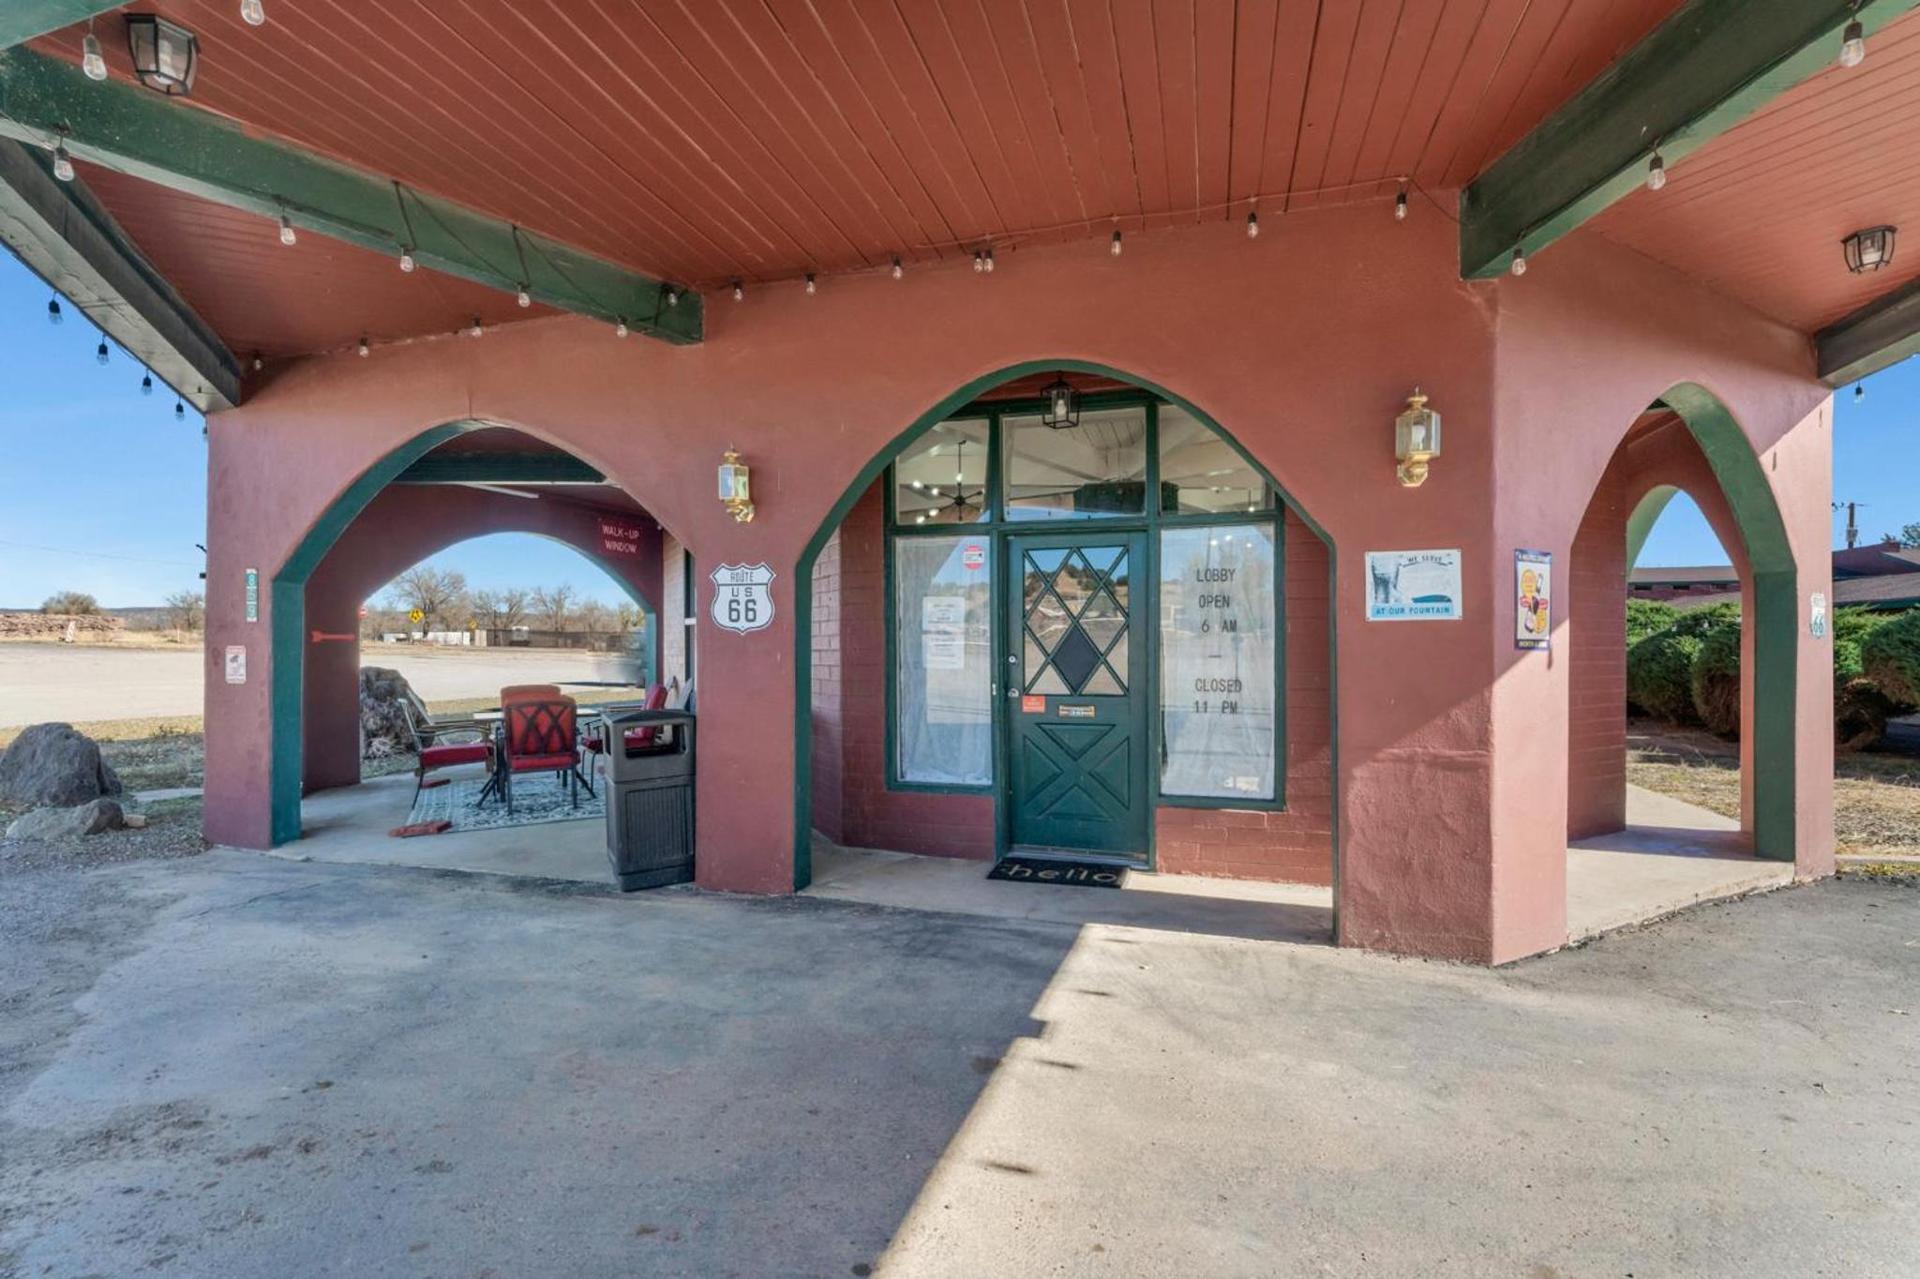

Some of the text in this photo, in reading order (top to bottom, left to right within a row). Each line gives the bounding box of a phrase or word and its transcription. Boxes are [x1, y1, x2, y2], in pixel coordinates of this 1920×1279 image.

[601, 524, 640, 540] WALK-UP
[604, 539, 638, 553] WINDOW
[730, 570, 754, 583] ROUTE
[1196, 567, 1236, 582] LOBBY
[1198, 594, 1231, 609] OPEN
[728, 598, 757, 623] 66
[1376, 606, 1450, 615] AT OUR FOUNTAIN
[1201, 619, 1238, 633] 6 AM
[1813, 615, 1824, 634] 66
[1195, 678, 1242, 693] CLOSED
[1195, 700, 1238, 714] 11 PM
[1008, 864, 1118, 882] hello
